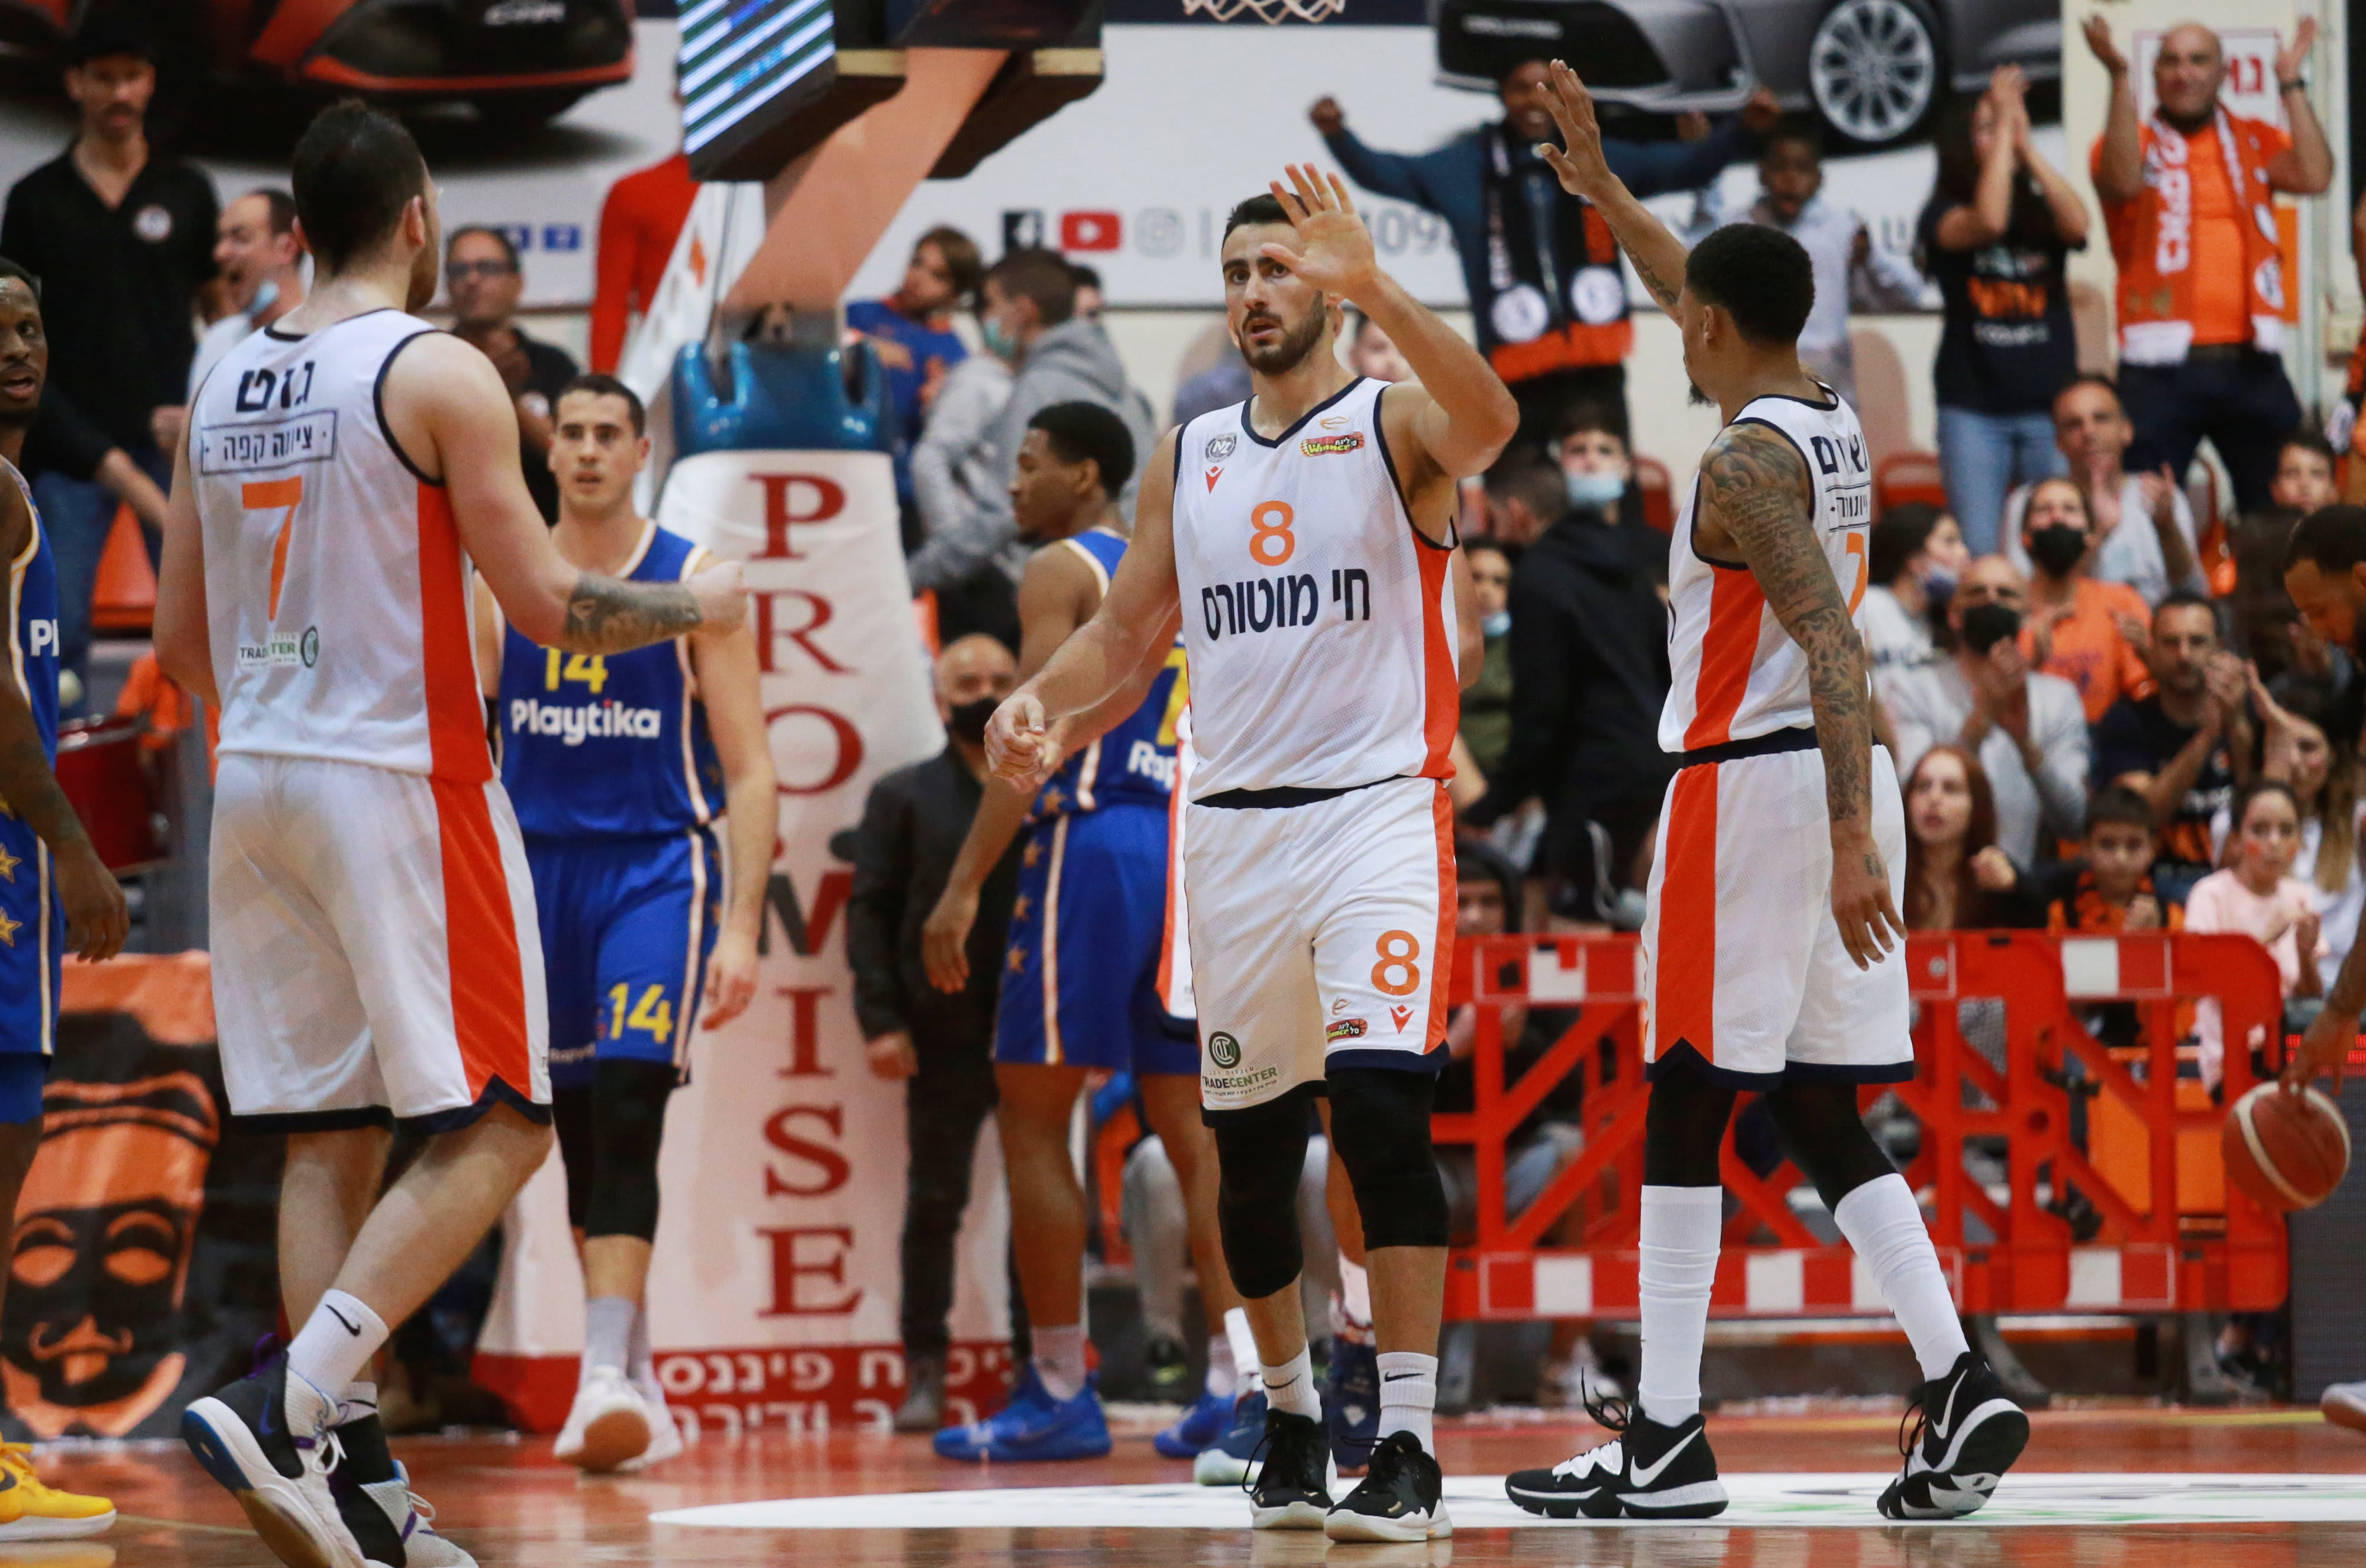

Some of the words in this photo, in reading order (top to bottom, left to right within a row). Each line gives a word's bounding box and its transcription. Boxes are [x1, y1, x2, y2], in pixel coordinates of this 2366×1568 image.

[224, 434, 265, 464] קפה
[1308, 443, 1350, 454] Winner
[241, 476, 303, 621] 7
[1249, 500, 1295, 566] 8
[1202, 573, 1318, 639] מוטורס
[1333, 568, 1370, 621] חי
[539, 645, 609, 693] 14
[510, 698, 661, 746] Playtika
[1127, 739, 1176, 790] Rap
[1371, 930, 1420, 996] 8
[609, 982, 673, 1044] 14
[1202, 1067, 1278, 1089] TRADECENTER
